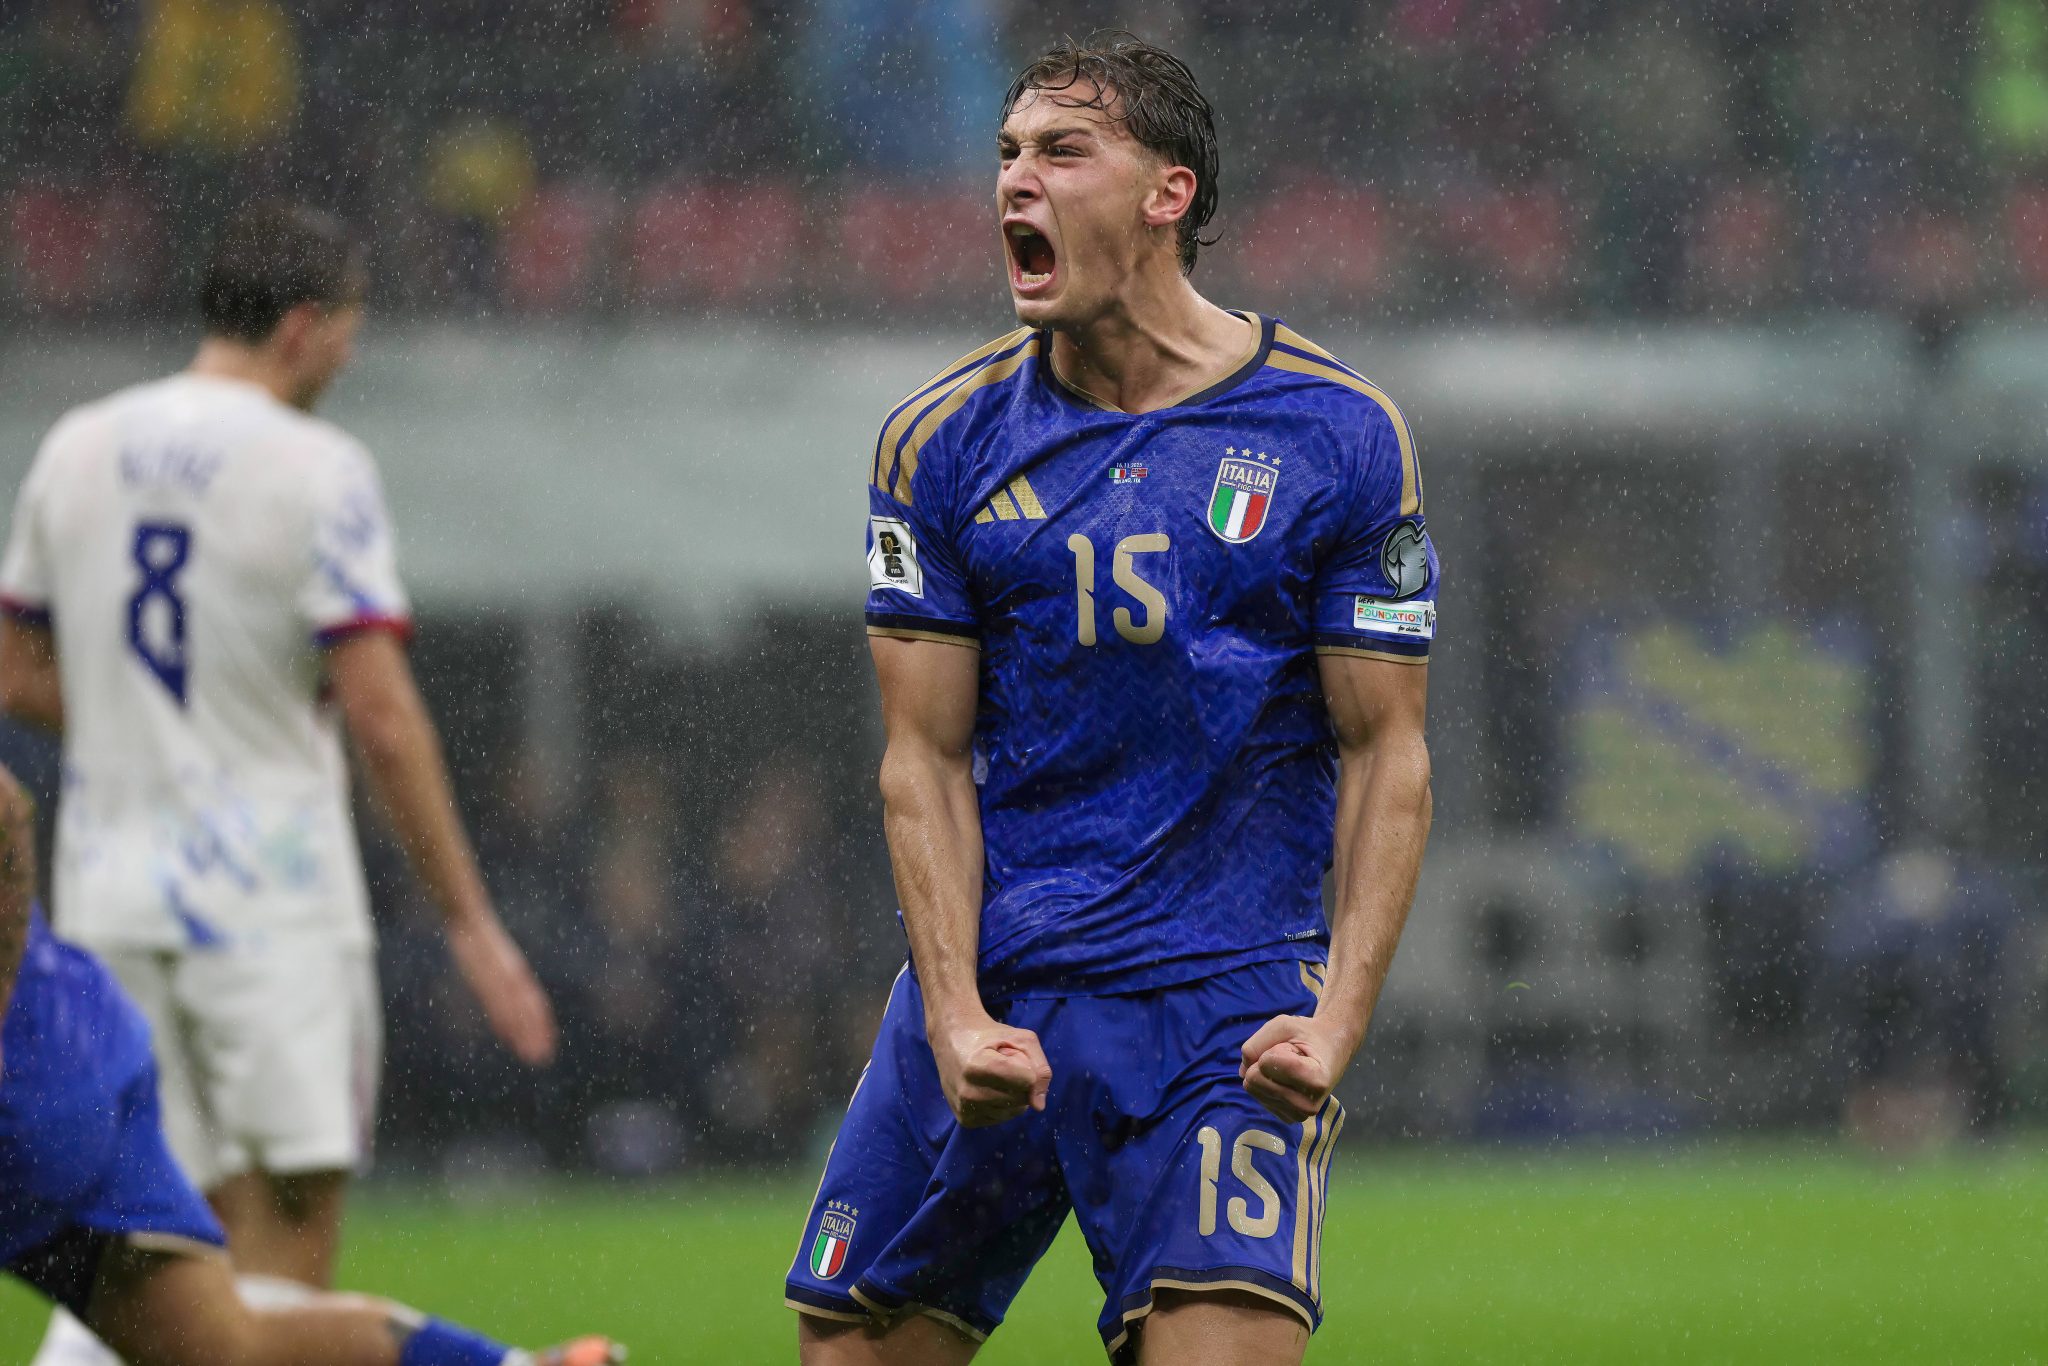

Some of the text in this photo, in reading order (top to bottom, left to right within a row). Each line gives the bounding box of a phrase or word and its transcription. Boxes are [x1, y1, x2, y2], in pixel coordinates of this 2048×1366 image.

[1222, 463, 1270, 489] ITALIA
[1237, 483, 1252, 492] FIGC
[1067, 533, 1171, 647] 15
[1358, 597, 1376, 605] UEFA
[127, 521, 190, 711] 8
[1356, 607, 1423, 623] FOUNDATION
[1197, 1126, 1287, 1239] 15
[823, 1215, 852, 1236] ITALIA
